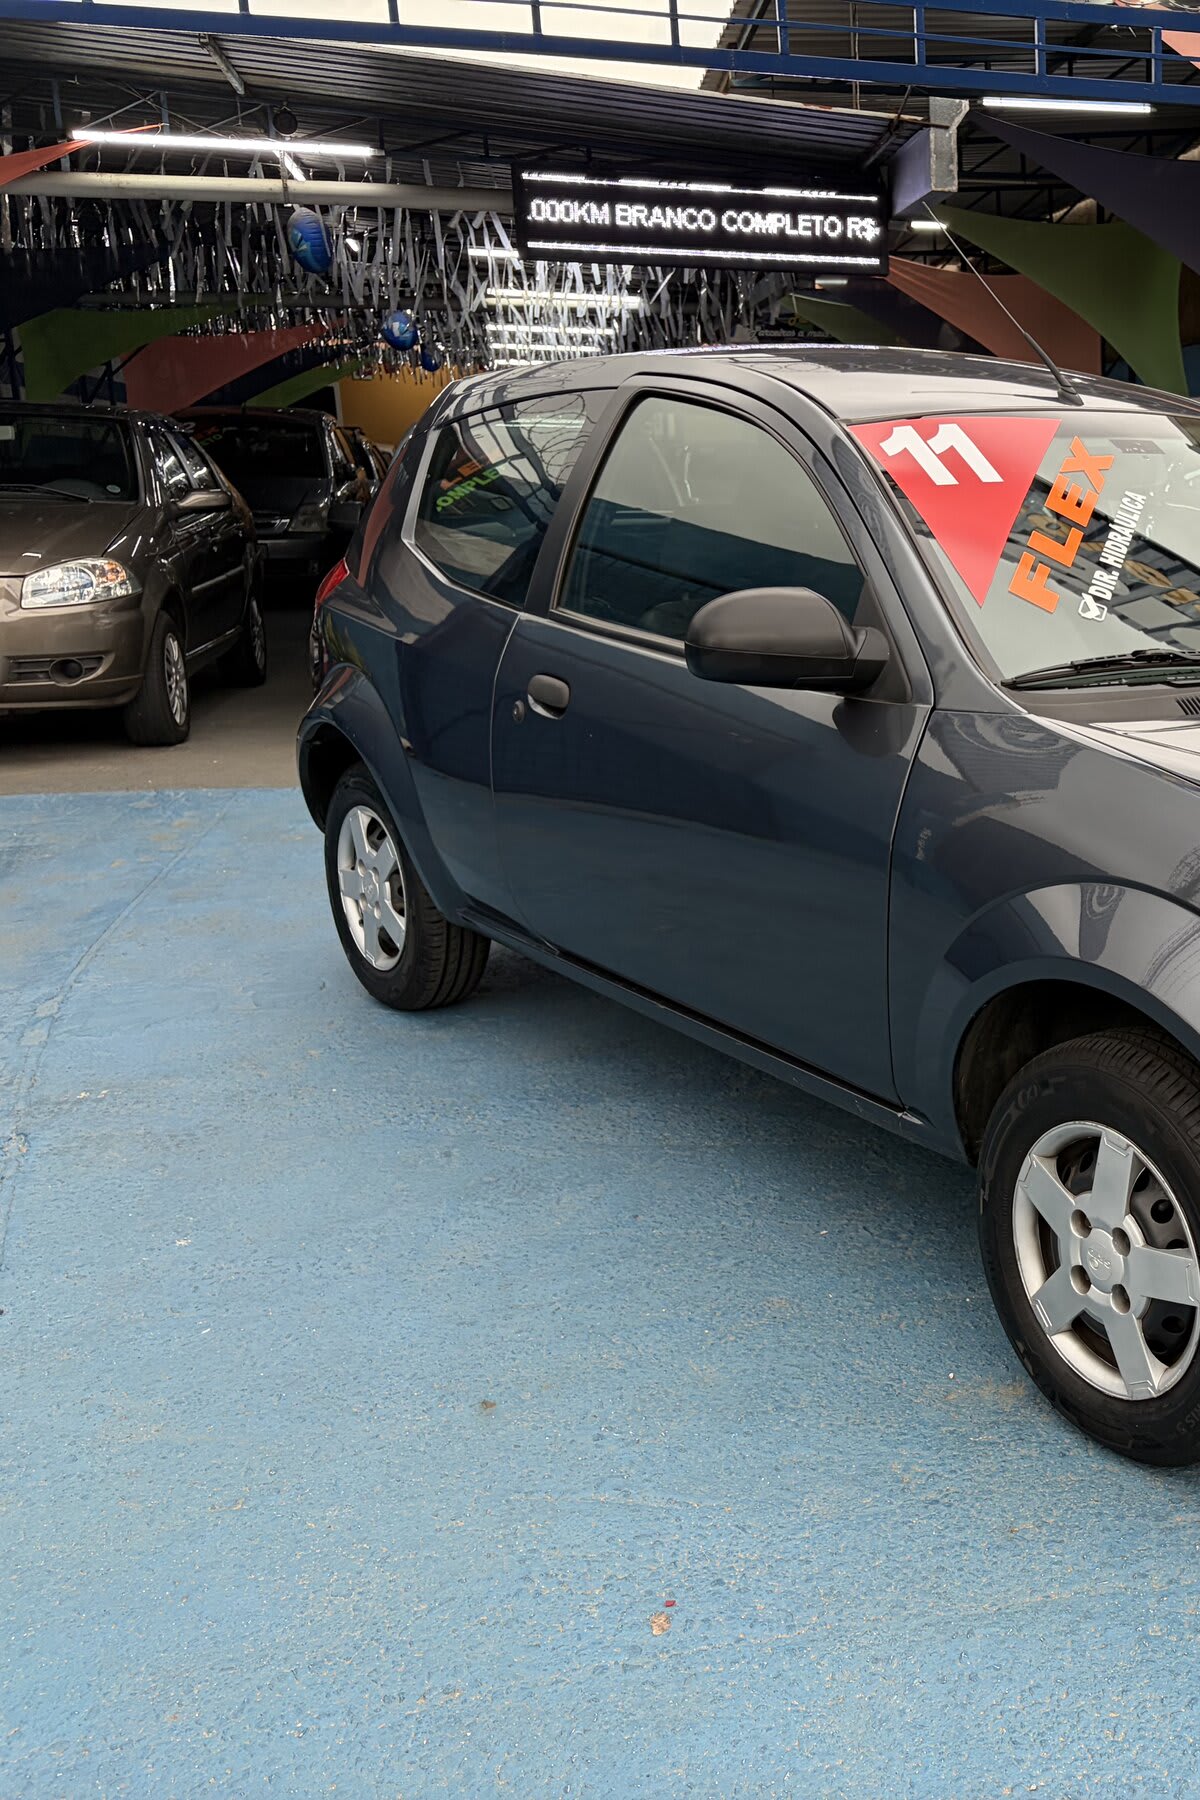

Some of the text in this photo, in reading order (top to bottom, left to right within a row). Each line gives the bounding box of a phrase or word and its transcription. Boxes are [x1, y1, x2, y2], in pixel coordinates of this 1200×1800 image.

[615, 203, 716, 231] BRANCO
[721, 210, 842, 238] COMPLETO
[847, 217, 881, 242] R$
[879, 423, 1005, 486] 11
[1008, 436, 1115, 613] FLEX
[1088, 568, 1120, 601] DIR.
